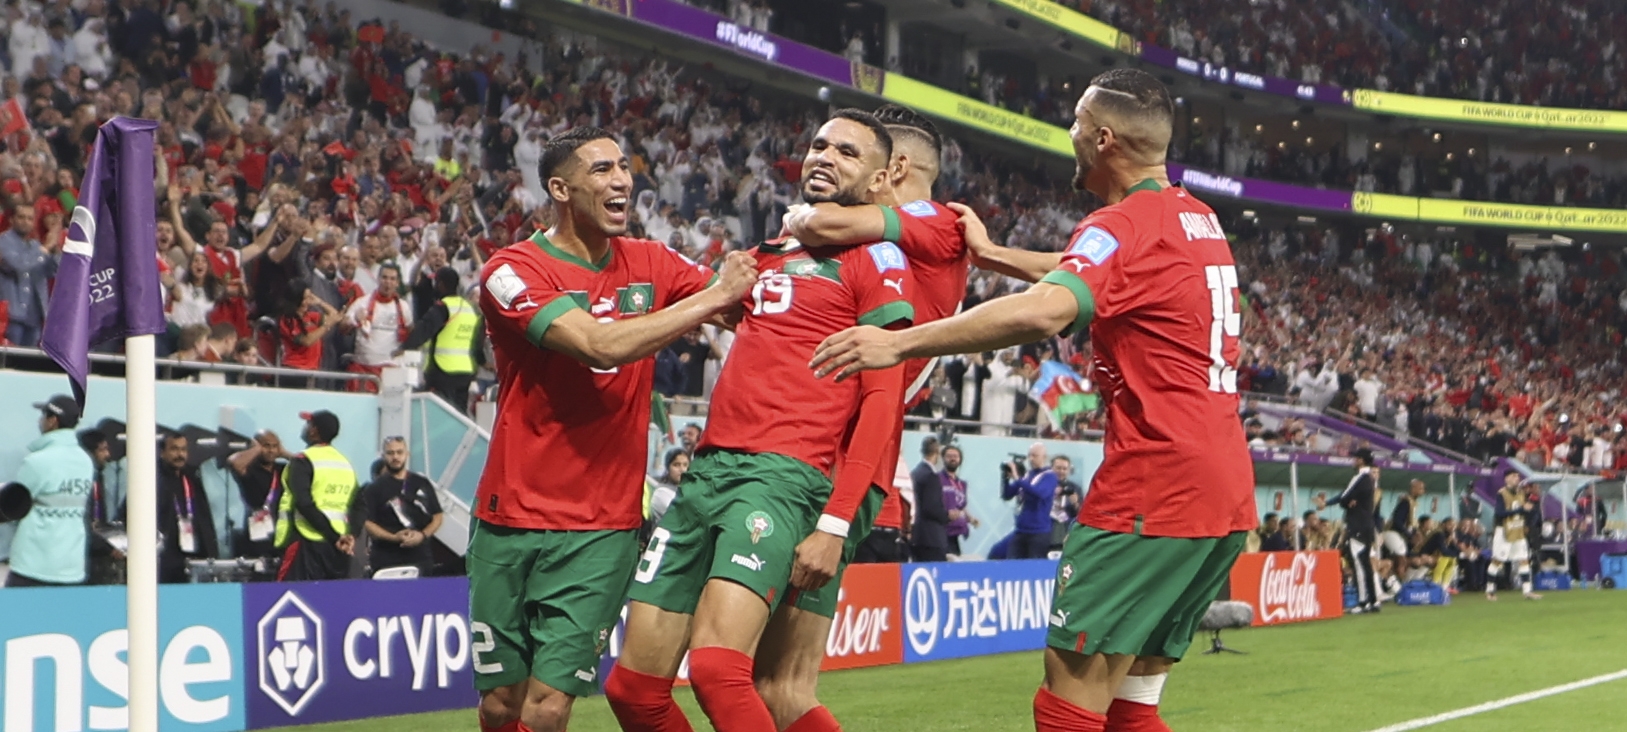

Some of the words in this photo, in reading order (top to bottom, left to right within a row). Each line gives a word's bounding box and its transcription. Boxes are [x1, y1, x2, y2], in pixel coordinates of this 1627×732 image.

[1204, 62, 1211, 77] 0
[1220, 67, 1228, 80] 0
[1462, 105, 1481, 115] FIFA
[1482, 106, 1515, 118] WORLD
[1515, 109, 1533, 120] CUP
[1183, 169, 1243, 196] #FIFAWorldCup
[1463, 206, 1485, 217] FIFA
[1486, 207, 1523, 220] WORLD
[1524, 211, 1544, 222] CUP
[89, 268, 115, 287] CUP
[752, 269, 793, 315] 19
[1204, 265, 1240, 393] 15
[942, 578, 997, 639] 万达
[343, 613, 468, 690] cryp
[471, 621, 504, 674] 2
